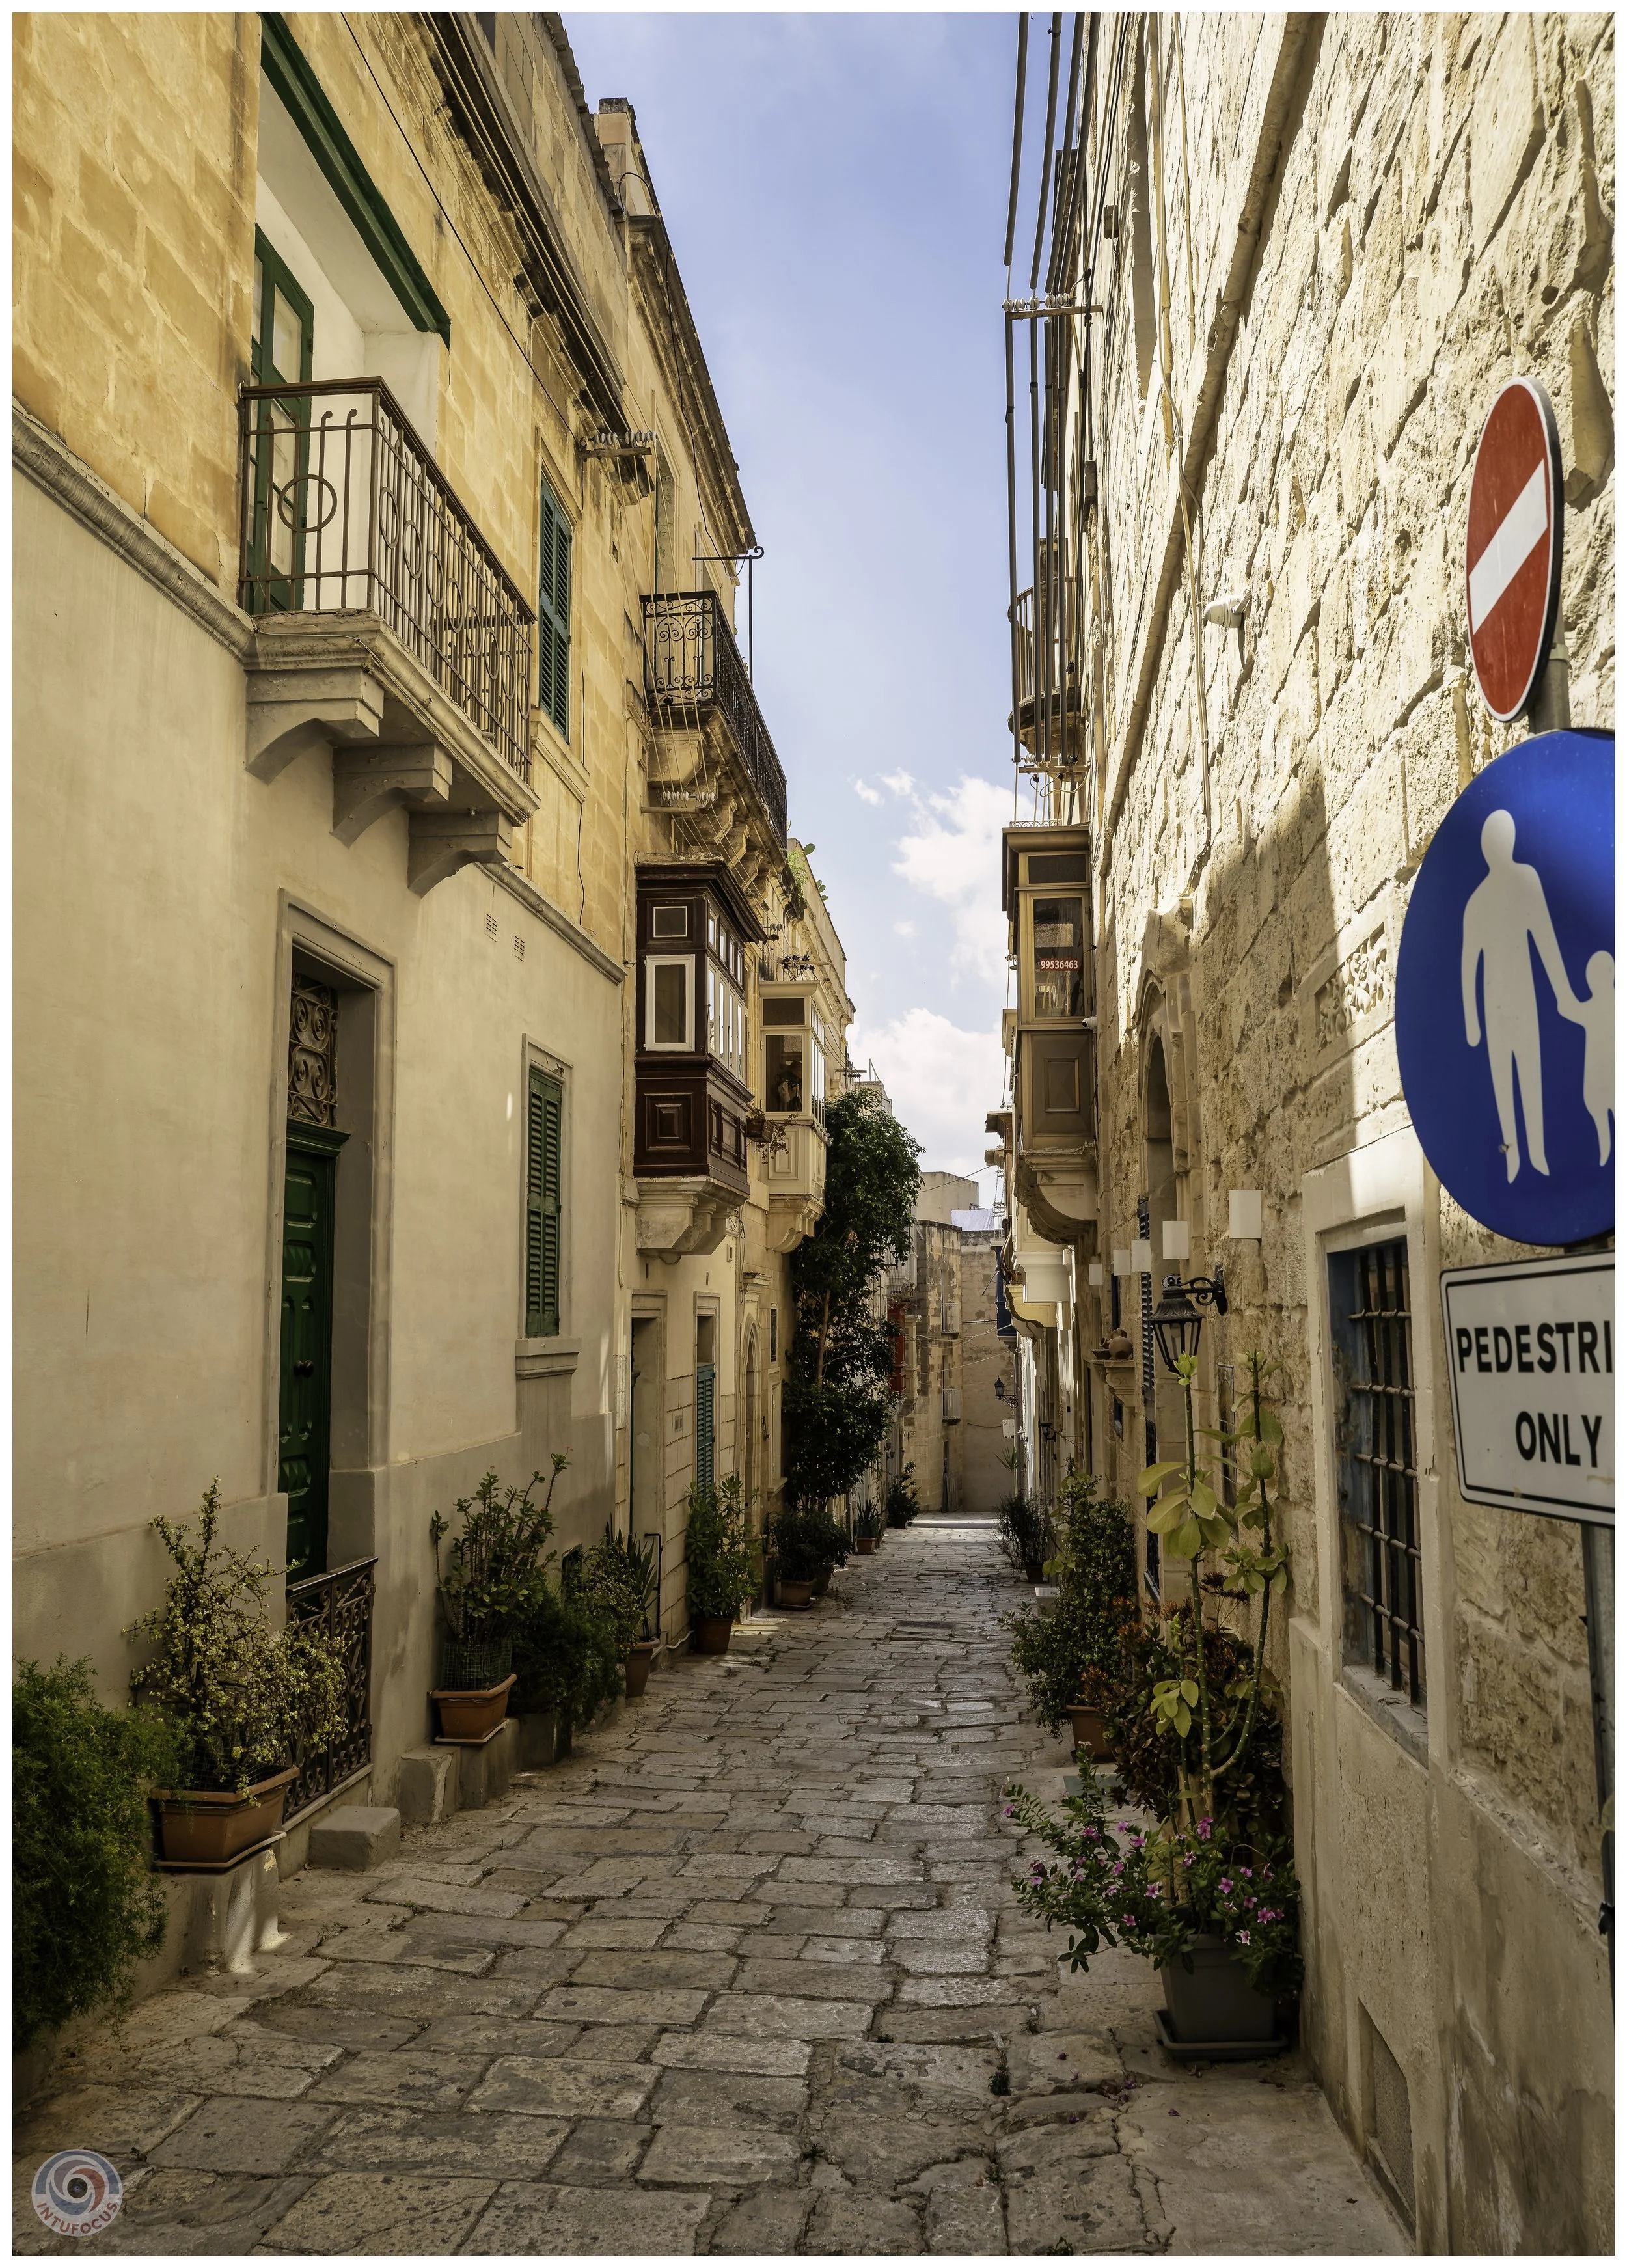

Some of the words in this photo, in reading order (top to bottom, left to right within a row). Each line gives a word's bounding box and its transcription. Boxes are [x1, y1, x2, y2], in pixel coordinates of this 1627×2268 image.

[1041, 960, 1078, 969] 99536463
[1456, 1320, 1613, 1373] PEDESTRI
[1515, 1411, 1602, 1468] ONLY
